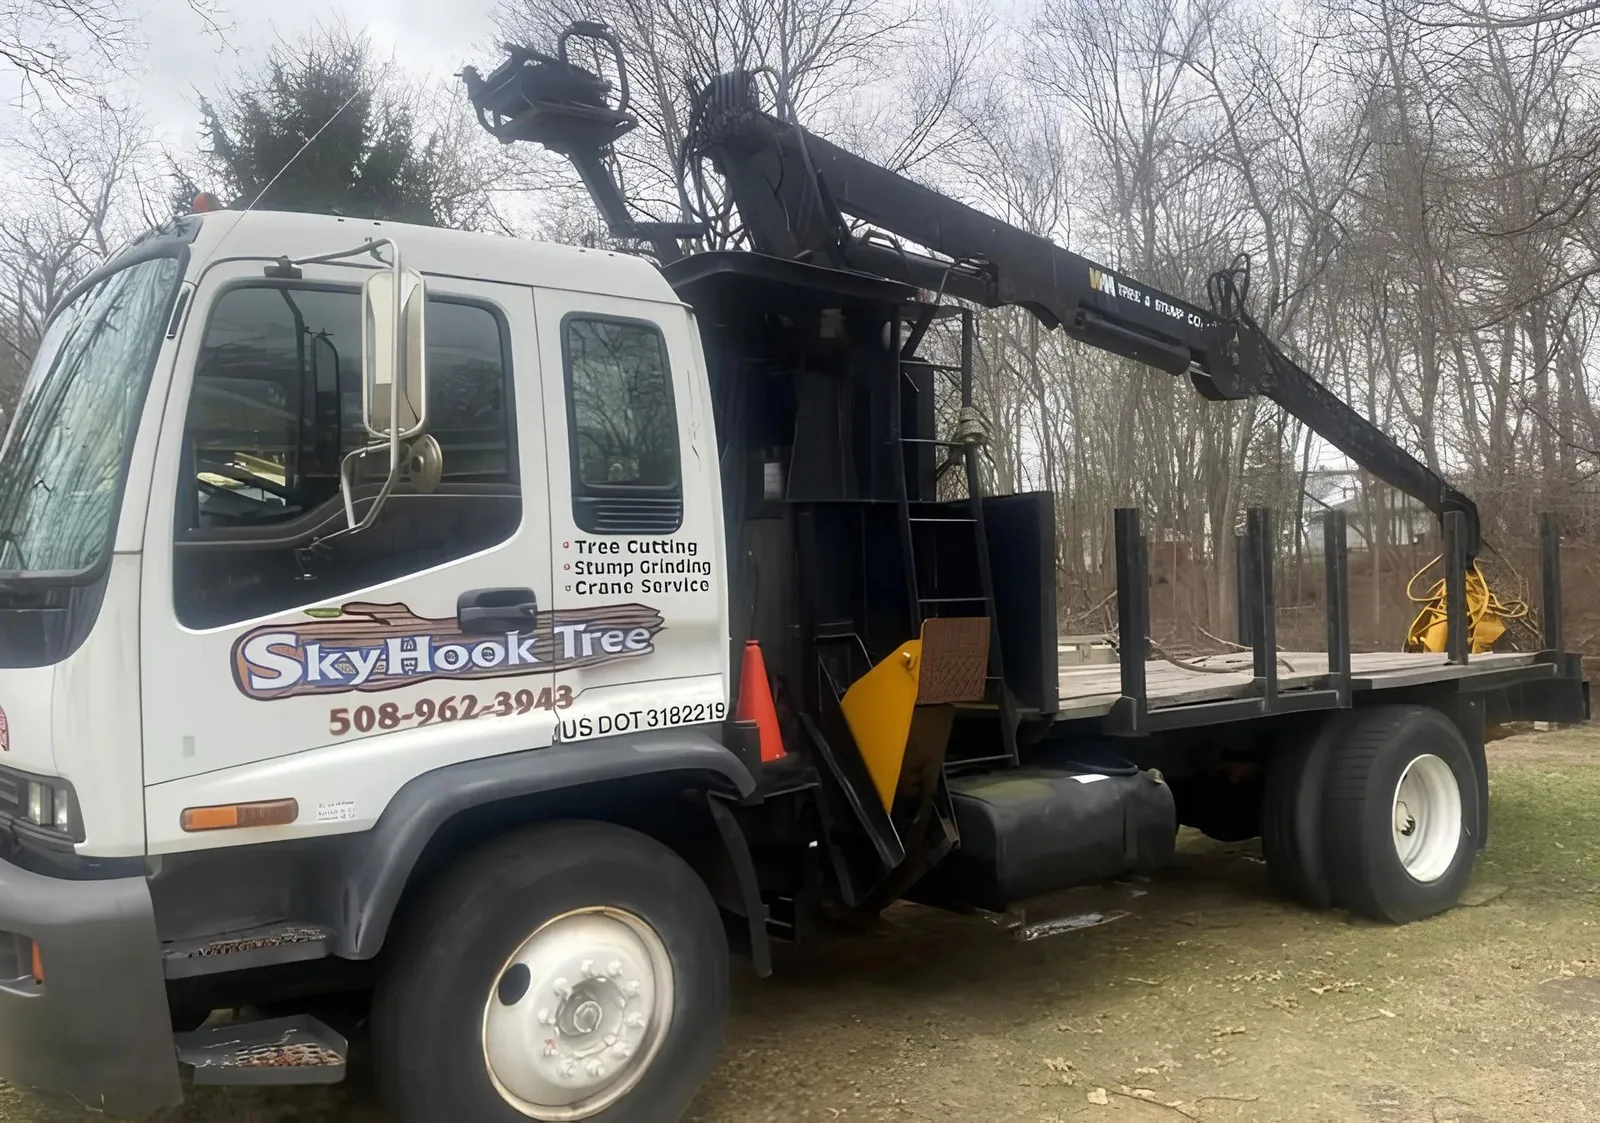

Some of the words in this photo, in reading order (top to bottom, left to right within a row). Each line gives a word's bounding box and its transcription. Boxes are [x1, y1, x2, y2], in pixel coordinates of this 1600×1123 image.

[575, 540, 620, 554] Tree
[627, 539, 697, 556] Cutting
[575, 561, 634, 577] Stump
[640, 559, 711, 575] Grinding
[553, 624, 652, 659] Tree
[329, 685, 574, 736] 508-962-3943
[562, 717, 593, 740] US
[599, 711, 643, 734] DOT
[647, 702, 725, 727] 3182219
